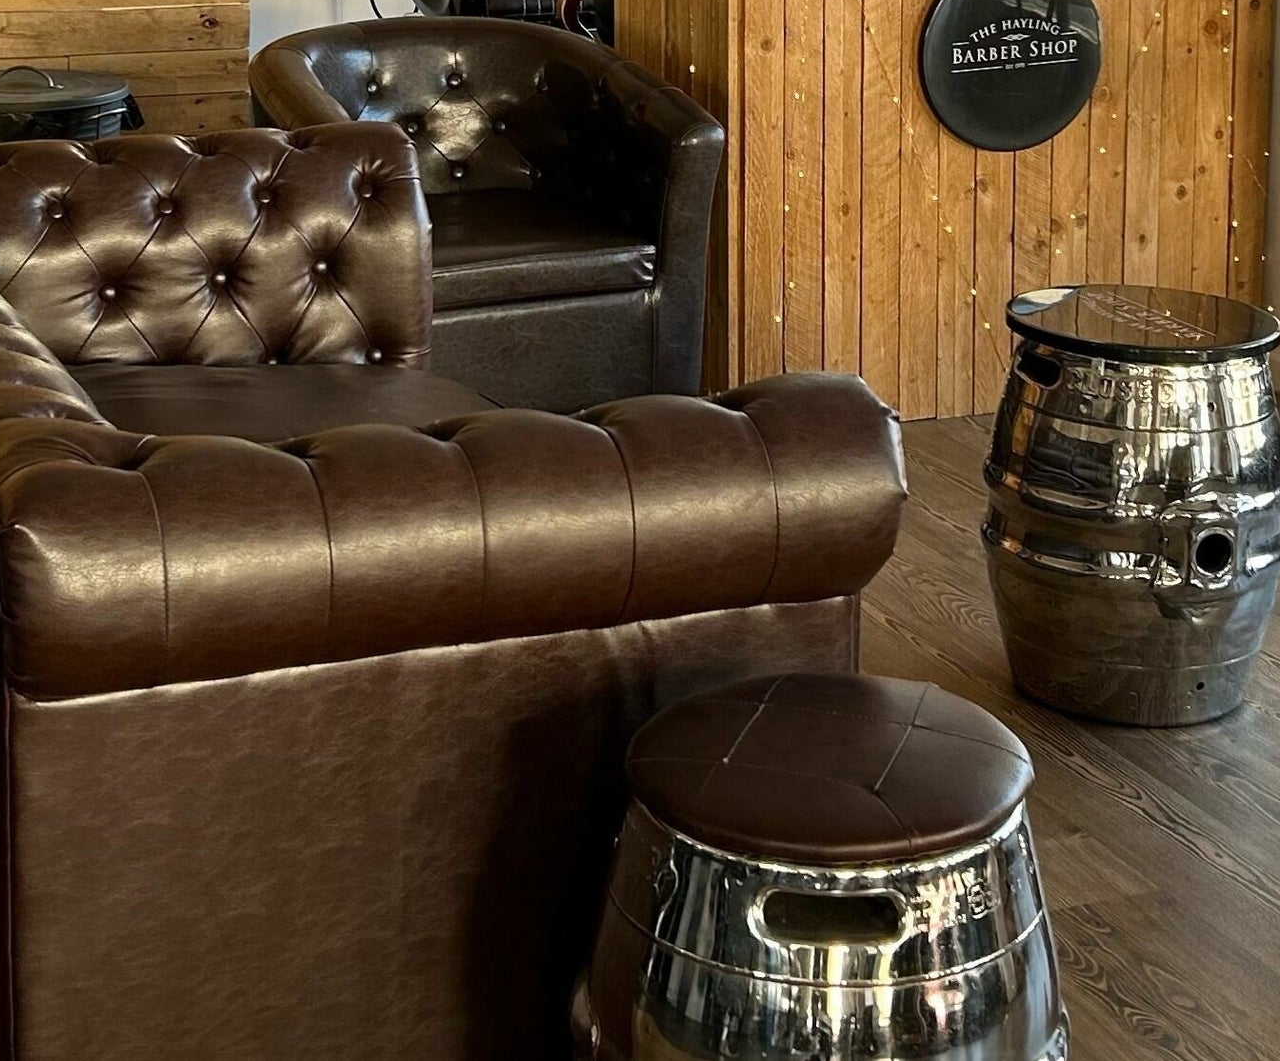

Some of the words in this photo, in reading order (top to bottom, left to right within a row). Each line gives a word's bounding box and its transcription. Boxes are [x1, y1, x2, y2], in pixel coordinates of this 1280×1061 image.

[969, 23, 997, 43] THE
[1001, 18, 1062, 36] HAYLING
[952, 44, 1022, 65] BARBER
[1029, 39, 1078, 57] SHOP
